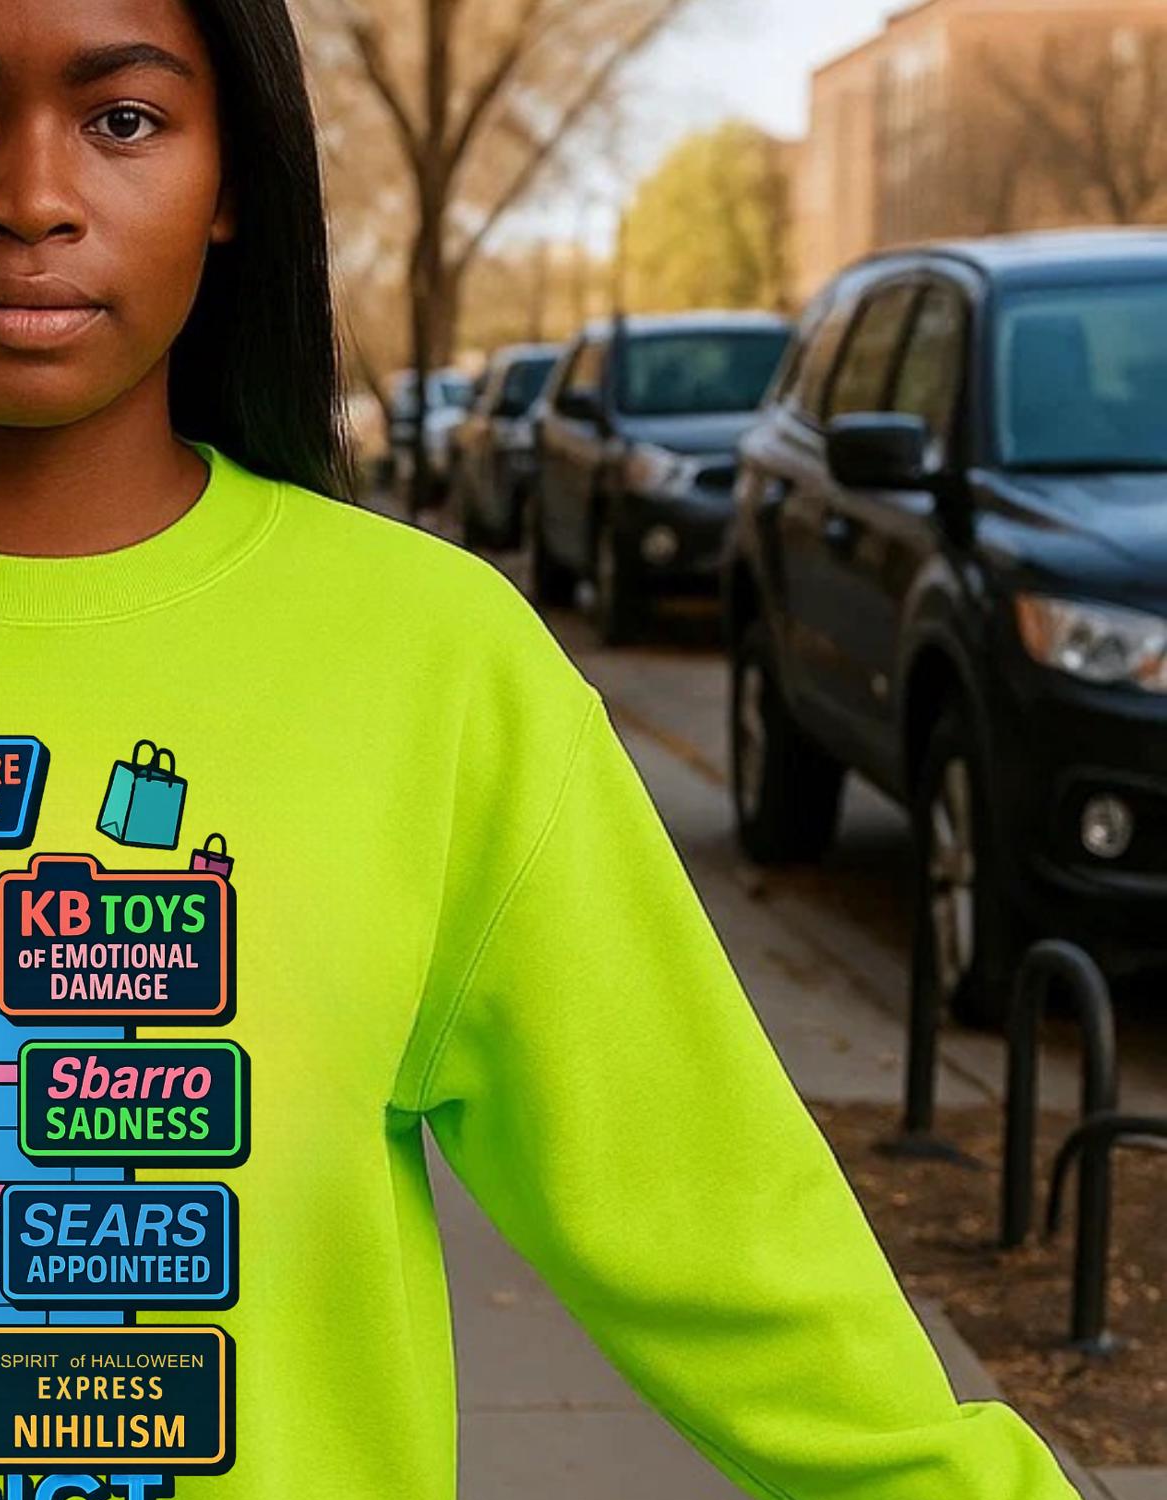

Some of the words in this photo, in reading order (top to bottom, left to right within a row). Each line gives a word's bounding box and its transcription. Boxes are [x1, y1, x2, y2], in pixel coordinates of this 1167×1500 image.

[20, 889, 92, 937] KB
[100, 894, 206, 934] TOYS
[51, 943, 199, 969] EMOTIONAL
[50, 973, 169, 1000] DAMAGE
[47, 1055, 212, 1101] Sbarro
[46, 1106, 210, 1141] SADNESS
[19, 1202, 210, 1248] SEARS
[26, 1255, 211, 1283] APPOINTEED
[0, 1354, 59, 1369] SPIRIT
[70, 1354, 86, 1369] of
[91, 1354, 204, 1369] HALLOWEEN
[37, 1375, 164, 1400] EXPRESS
[13, 1414, 186, 1448] NIHILISM
